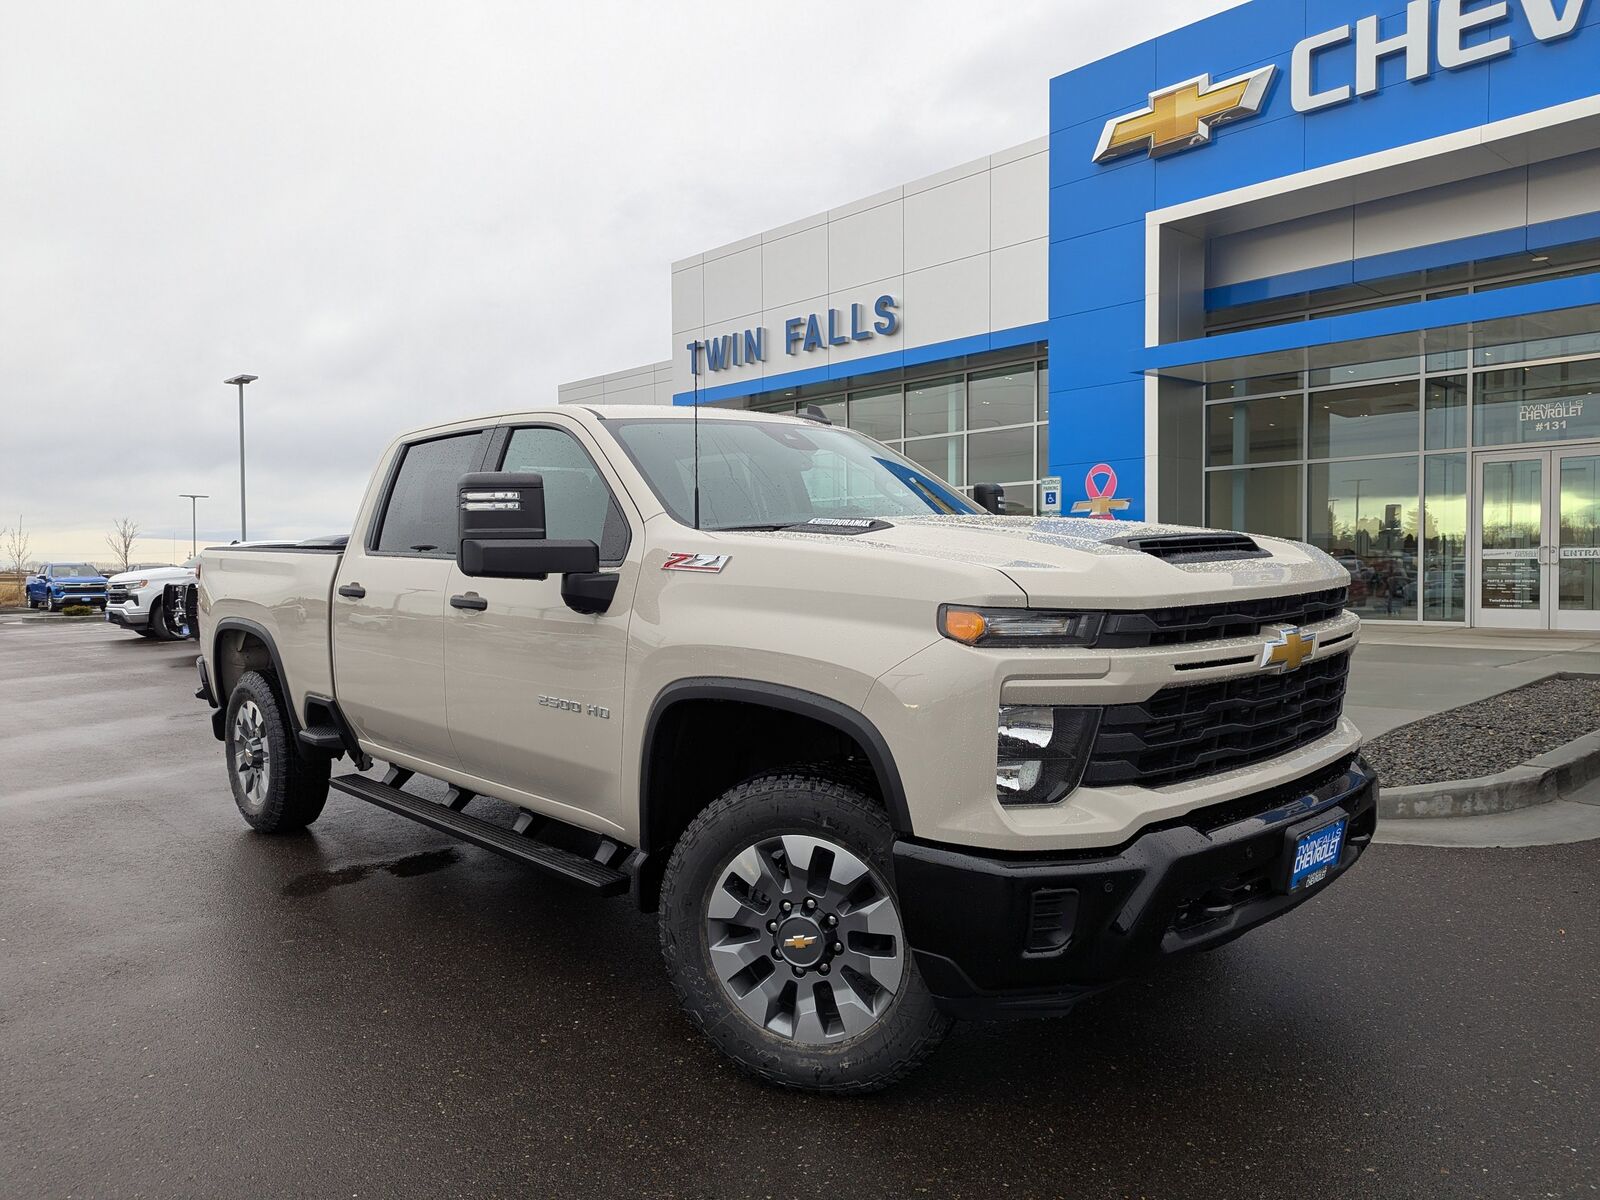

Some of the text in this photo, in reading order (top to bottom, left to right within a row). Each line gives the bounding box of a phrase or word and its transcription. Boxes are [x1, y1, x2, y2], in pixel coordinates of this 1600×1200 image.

[687, 295, 899, 375] TWIN FALLS
[1520, 406, 1583, 421] CHEVROLET
[1536, 420, 1567, 431] #131
[660, 552, 733, 574] Z71
[1563, 549, 1599, 557] ENTRA
[538, 695, 610, 719] 2500 HD
[1294, 840, 1338, 874] CHEVROLET
